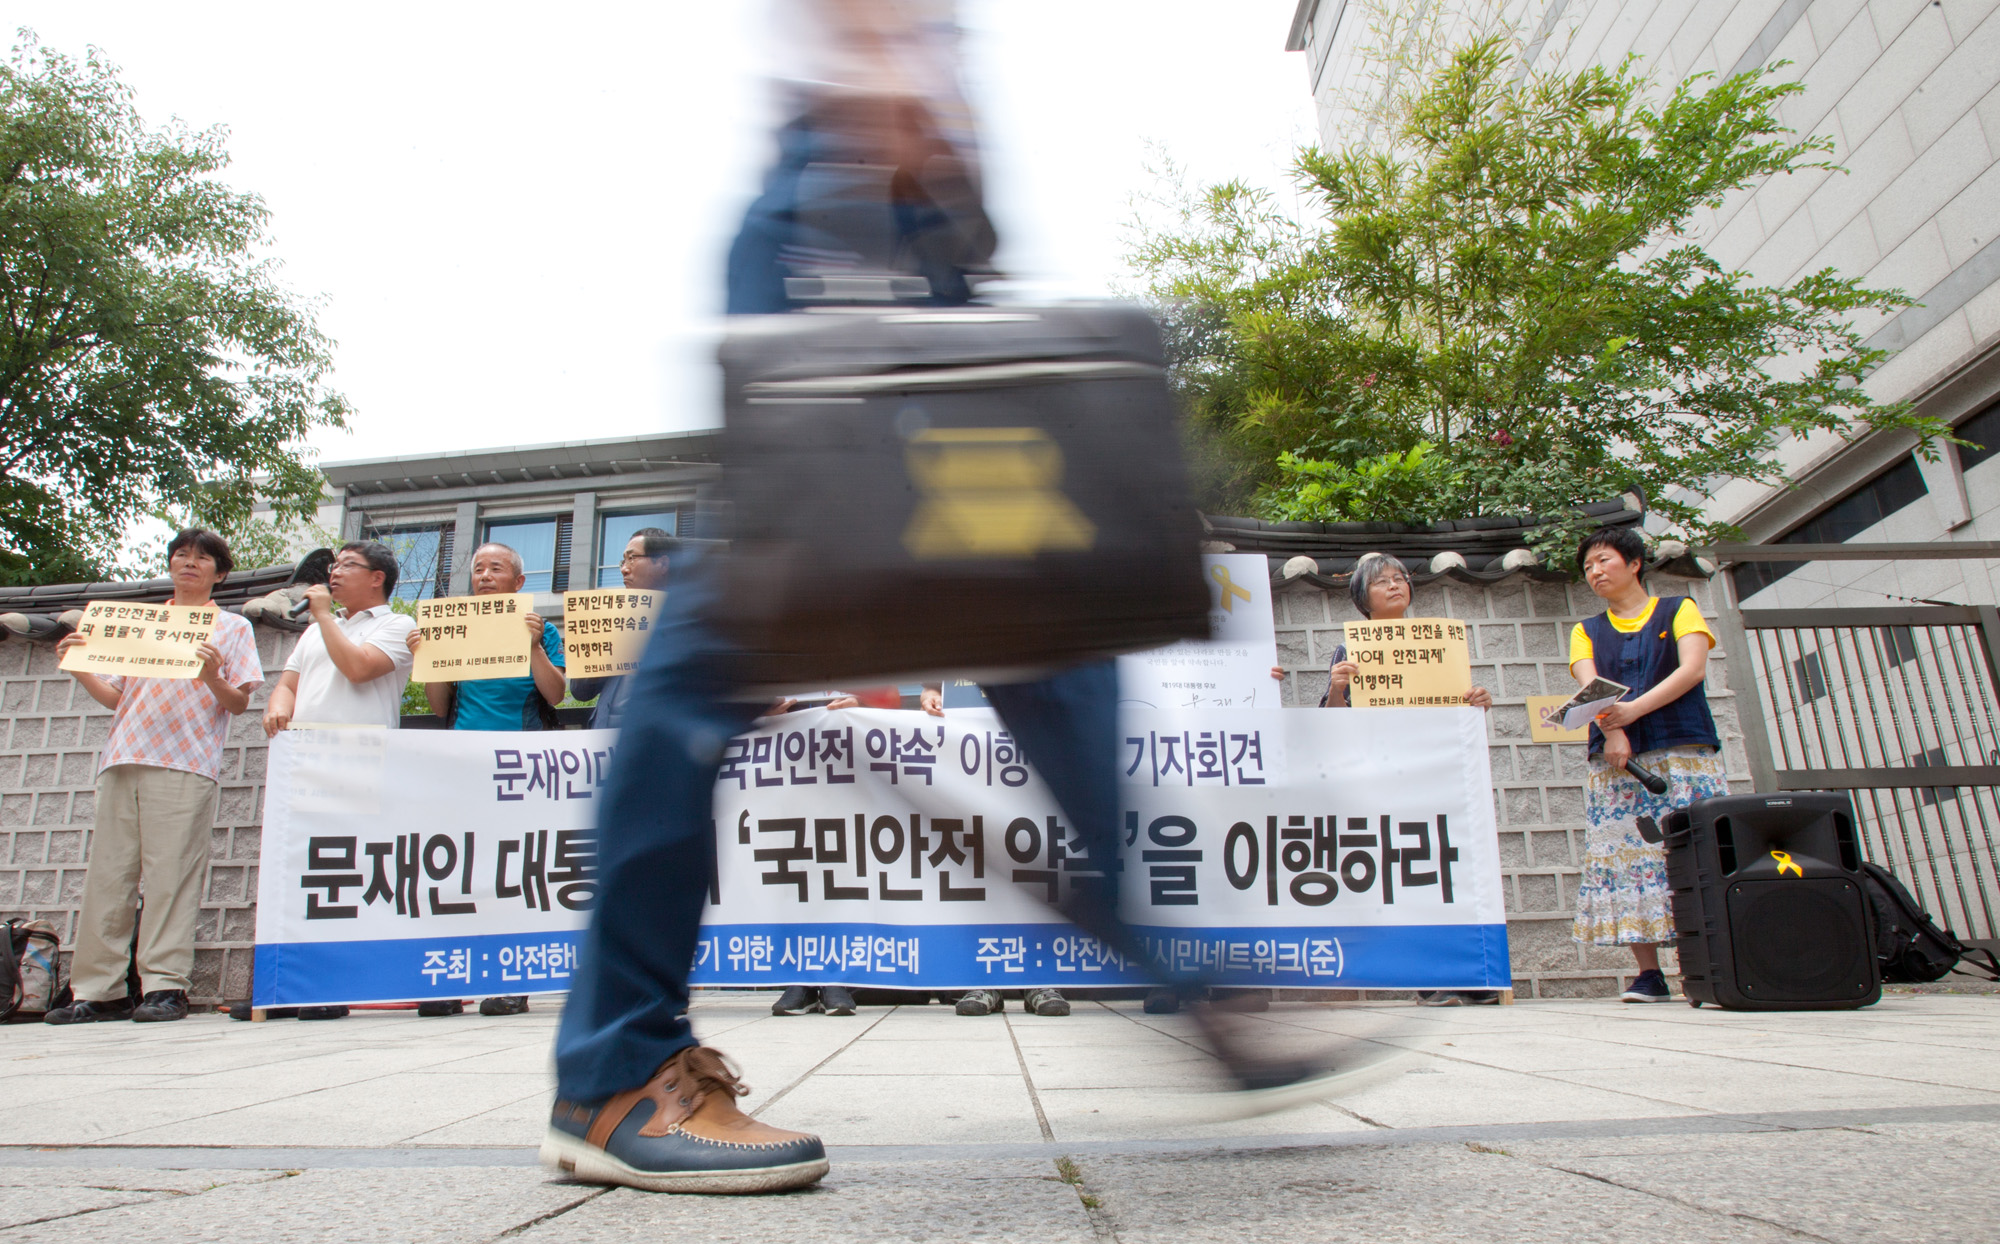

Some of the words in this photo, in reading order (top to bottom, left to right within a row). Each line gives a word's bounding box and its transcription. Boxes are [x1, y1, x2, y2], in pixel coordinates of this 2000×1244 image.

[421, 598, 517, 619] 국민안전기본법을
[567, 595, 653, 612] 문재인대통령의
[89, 605, 171, 623] 생명안전권을
[188, 611, 215, 625] 헌법
[81, 623, 96, 637] 과
[104, 624, 146, 639] 법률에
[155, 628, 210, 644] 명시하라
[420, 625, 468, 641] 제정하라
[567, 616, 649, 635] 국민안전약속을
[1348, 625, 1406, 642] 국민생명과
[1411, 624, 1443, 640] 안전을
[1447, 625, 1464, 641] 위한
[568, 641, 613, 658] 이행하라
[88, 654, 125, 664] 안전사회
[432, 658, 462, 668] 안전사회
[466, 655, 528, 667] 시민네트워크(준)
[584, 663, 613, 673] 안전사회
[1184, 681, 1203, 689] 대통령
[1352, 674, 1403, 690] 이행하라
[1369, 696, 1404, 706] 안전사회
[865, 726, 945, 786] 약속’
[1125, 730, 1266, 787] 기자회견
[300, 831, 477, 920] 문재인
[738, 809, 986, 903] ‘국민안전
[1223, 814, 1459, 907] 이행하라
[421, 947, 471, 986] 주최
[727, 936, 774, 972] 위한
[780, 935, 920, 975] 시민사회연대
[975, 936, 1027, 974] 주관
